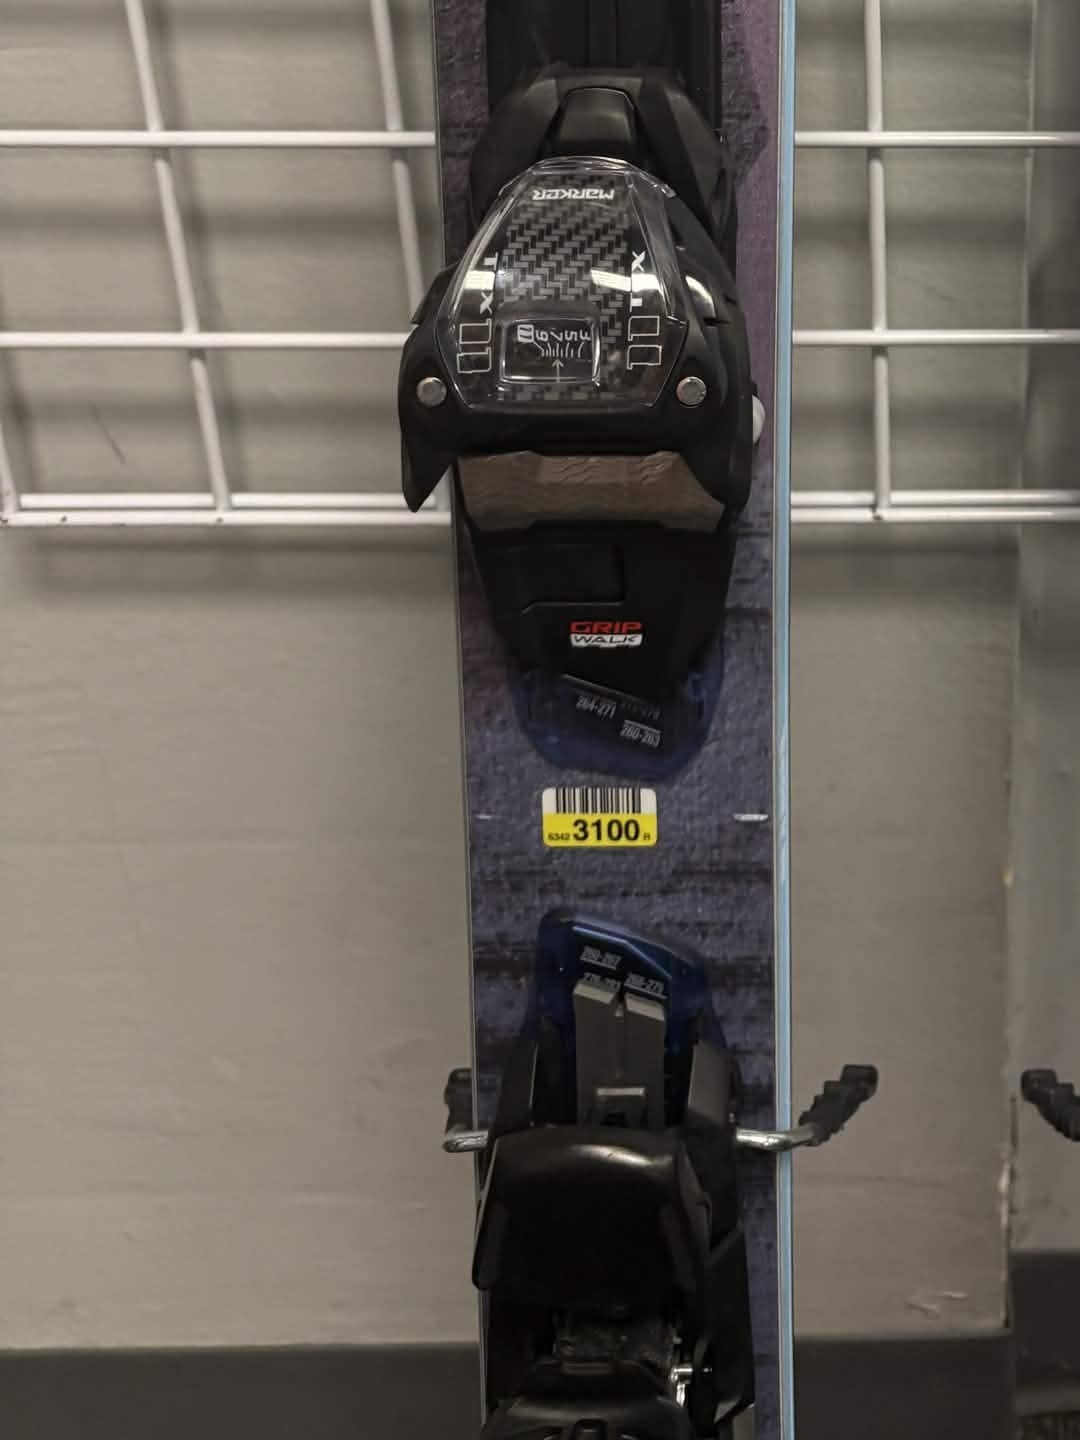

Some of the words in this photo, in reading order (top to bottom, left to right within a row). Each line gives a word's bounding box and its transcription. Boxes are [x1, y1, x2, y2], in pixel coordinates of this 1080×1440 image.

[570, 621, 642, 633] GRIP
[573, 635, 641, 644] WALK
[573, 819, 640, 841] 3100
